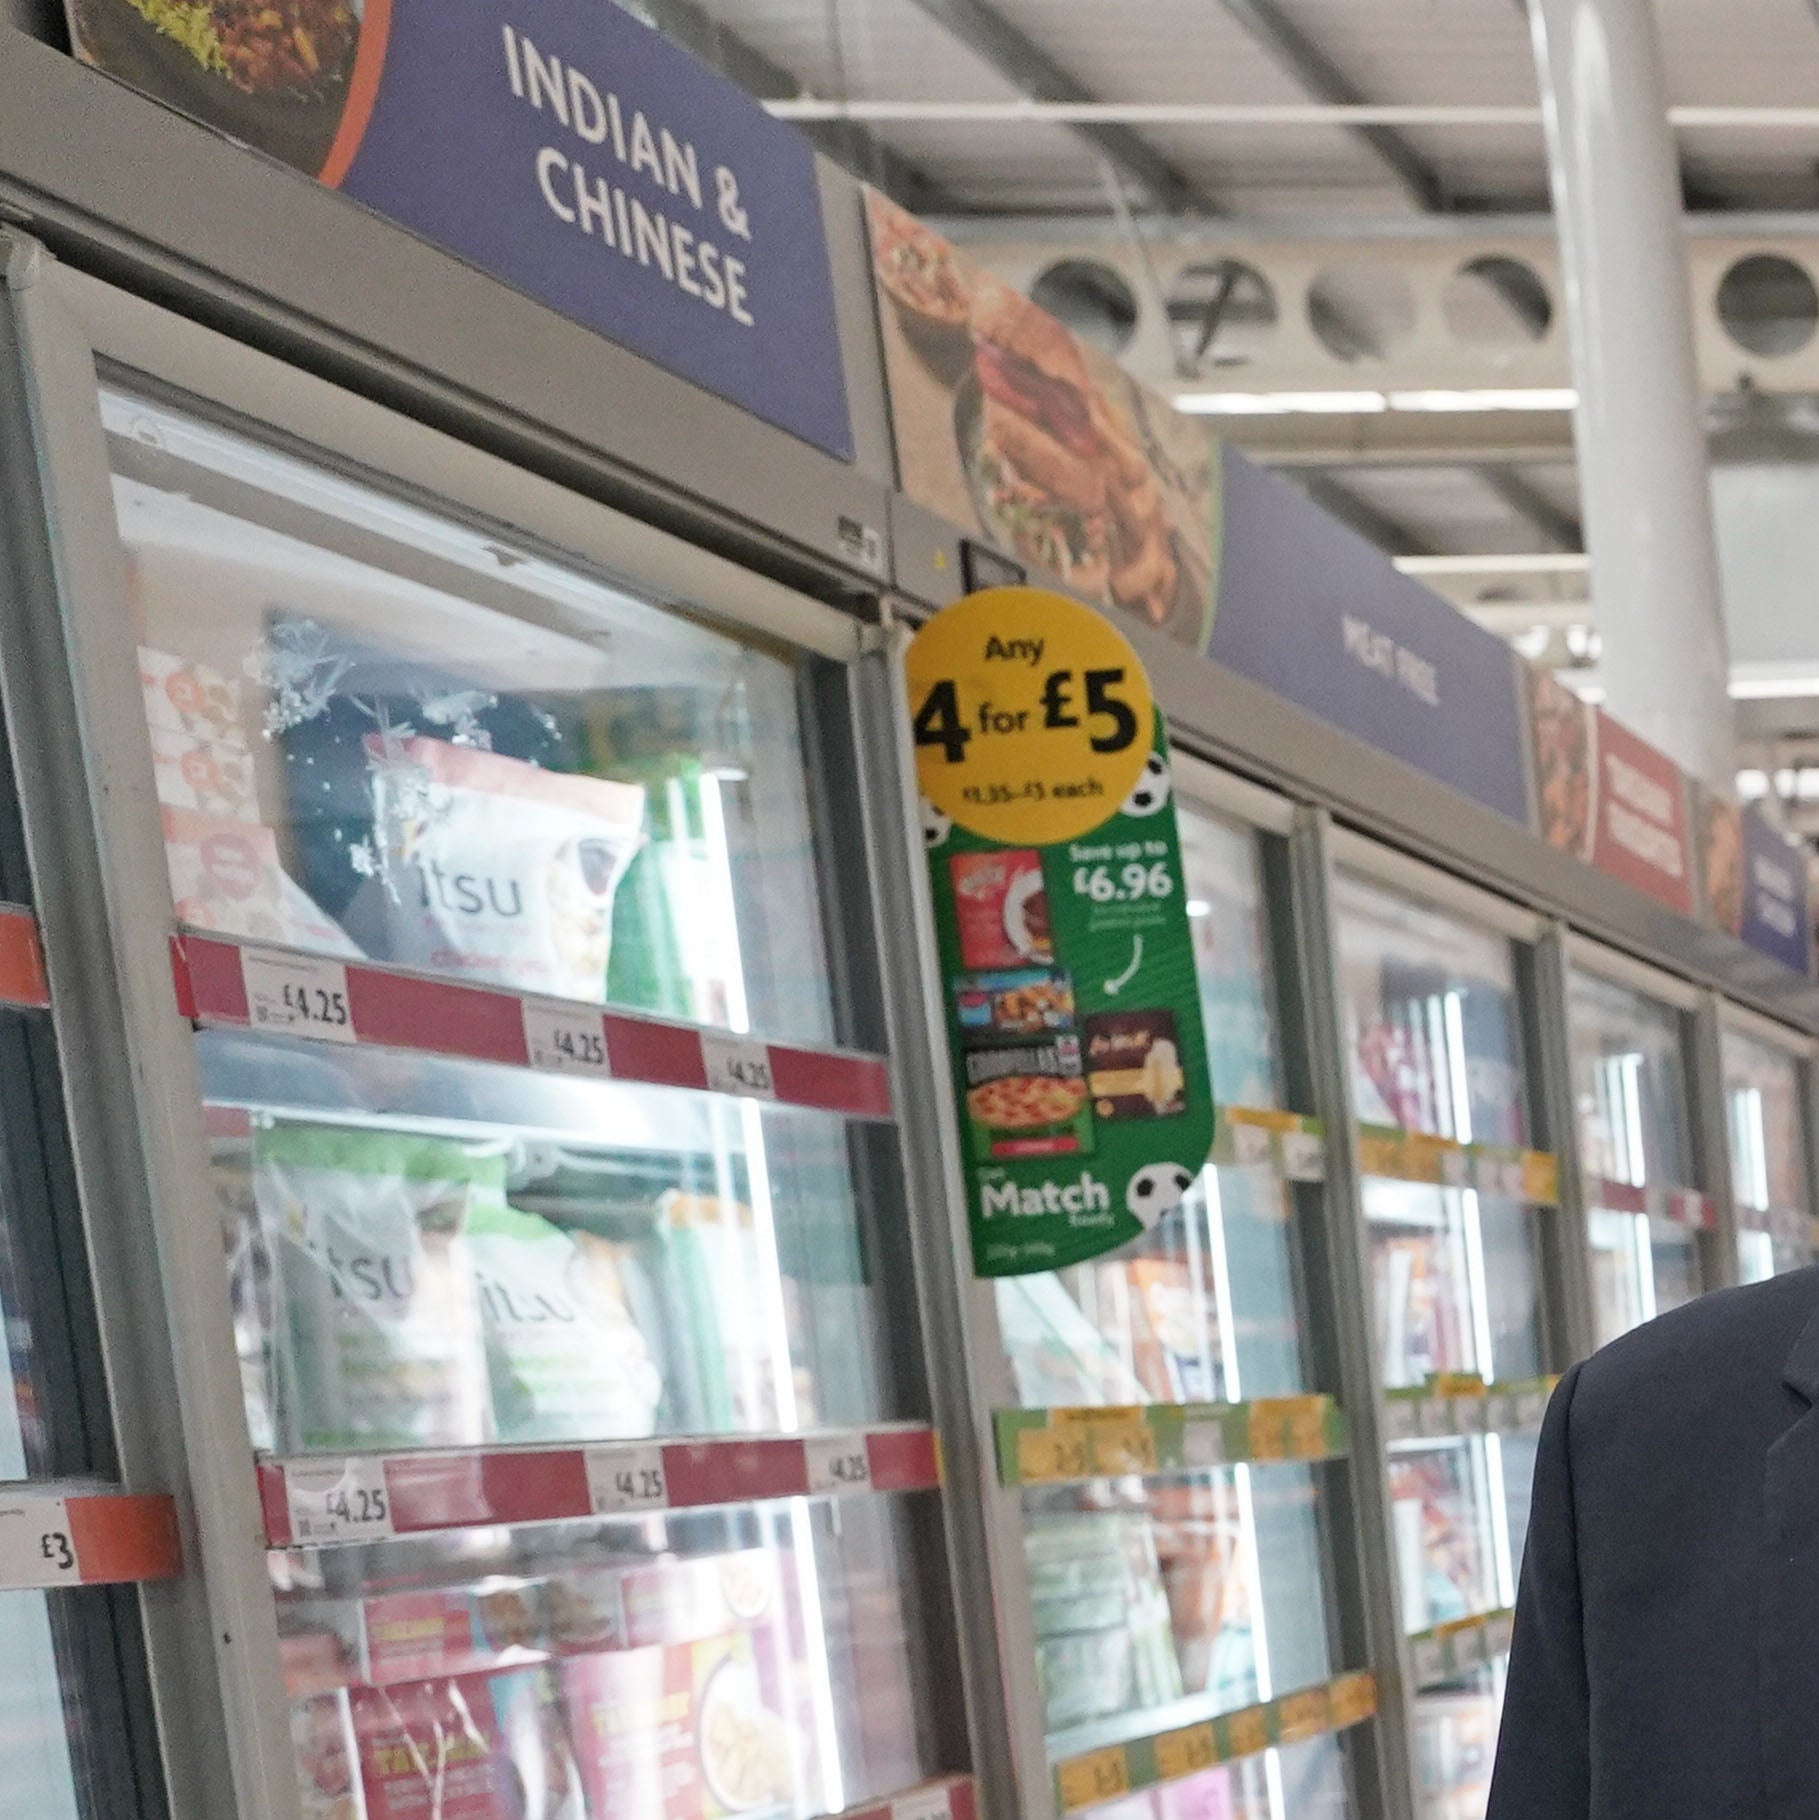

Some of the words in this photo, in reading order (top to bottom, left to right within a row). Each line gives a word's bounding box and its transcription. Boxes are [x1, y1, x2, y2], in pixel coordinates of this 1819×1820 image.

[503, 22, 702, 211] INDIAN
[715, 164, 752, 242] &
[536, 146, 755, 328] CHINESE
[984, 634, 1045, 667] Any
[913, 678, 972, 764] 4
[977, 700, 1029, 735] for
[1038, 667, 1139, 755] £5
[1051, 776, 1104, 800] each
[411, 849, 524, 918] itsu
[1072, 861, 1174, 902] £6.96
[283, 983, 347, 1026] £4.25
[553, 1027, 605, 1065] £4.25
[980, 1170, 1111, 1219] Match
[616, 1468, 663, 1498] £4.25
[326, 1488, 387, 1524] £4.25
[42, 1532, 74, 1569] £3
